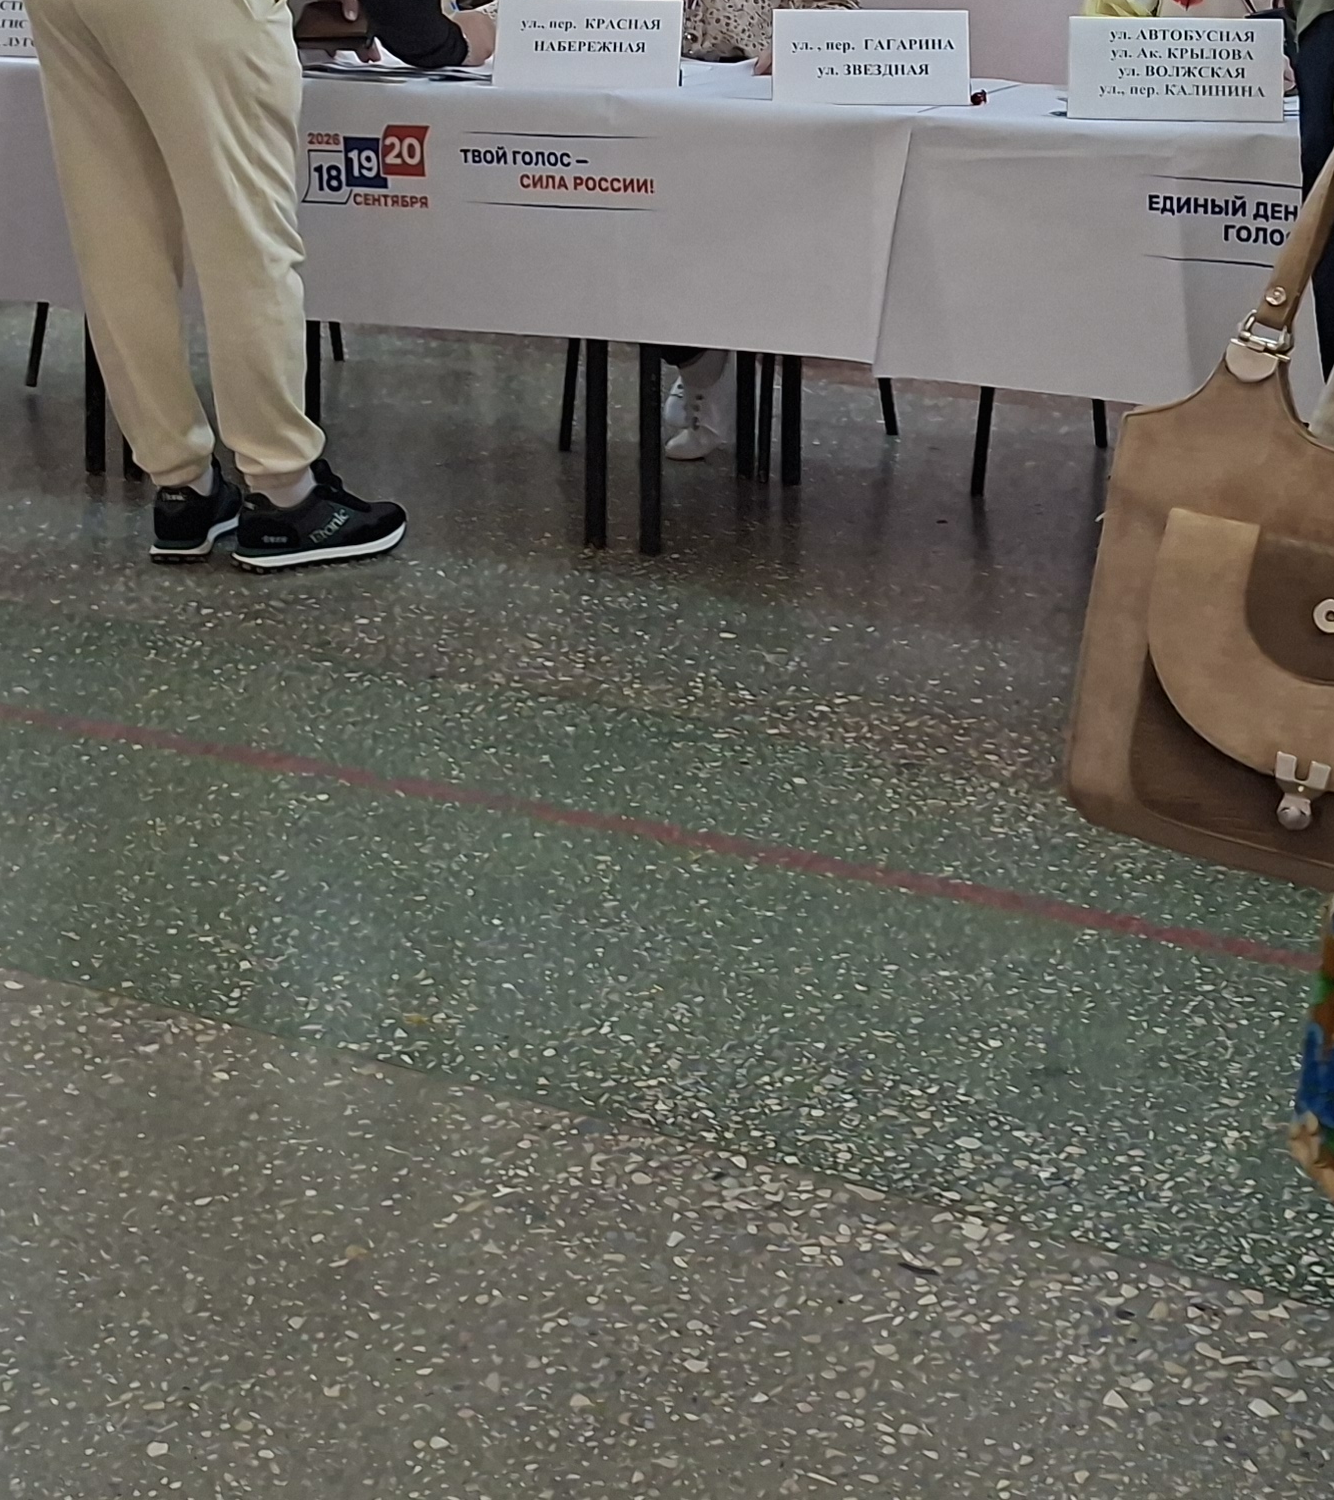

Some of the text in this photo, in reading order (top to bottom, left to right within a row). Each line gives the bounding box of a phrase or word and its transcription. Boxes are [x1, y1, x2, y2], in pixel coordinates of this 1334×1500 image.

[549, 20, 577, 32] пер.
[585, 18, 661, 30] КРАСНАЯ
[1109, 29, 1255, 43] ул. АВТОБУСНАЯ
[534, 40, 646, 53] НАБЕРЕЖНАЯ
[826, 42, 856, 53] пер.
[864, 38, 955, 51] ГАГАРИНА
[1110, 49, 1255, 61] ул. Ак. КРЫЛОВА
[817, 64, 929, 78] ул. ЗВЕЗДНАЯ
[1118, 66, 1246, 79] ул. ВОЛЖСКАЯ
[1130, 86, 1160, 98] пер.
[1165, 84, 1266, 98] КАЛИНИНА
[307, 132, 341, 146] 2026
[460, 146, 508, 165] ТВОЙ
[512, 150, 571, 167] ГОЛОС
[313, 136, 421, 192] 18 19 20
[519, 174, 655, 194] СИЛА РОССИИ!
[353, 193, 428, 208] СЕНТЯБРЯ
[1147, 194, 1298, 222] ЕДИНЫЙ ДЕН
